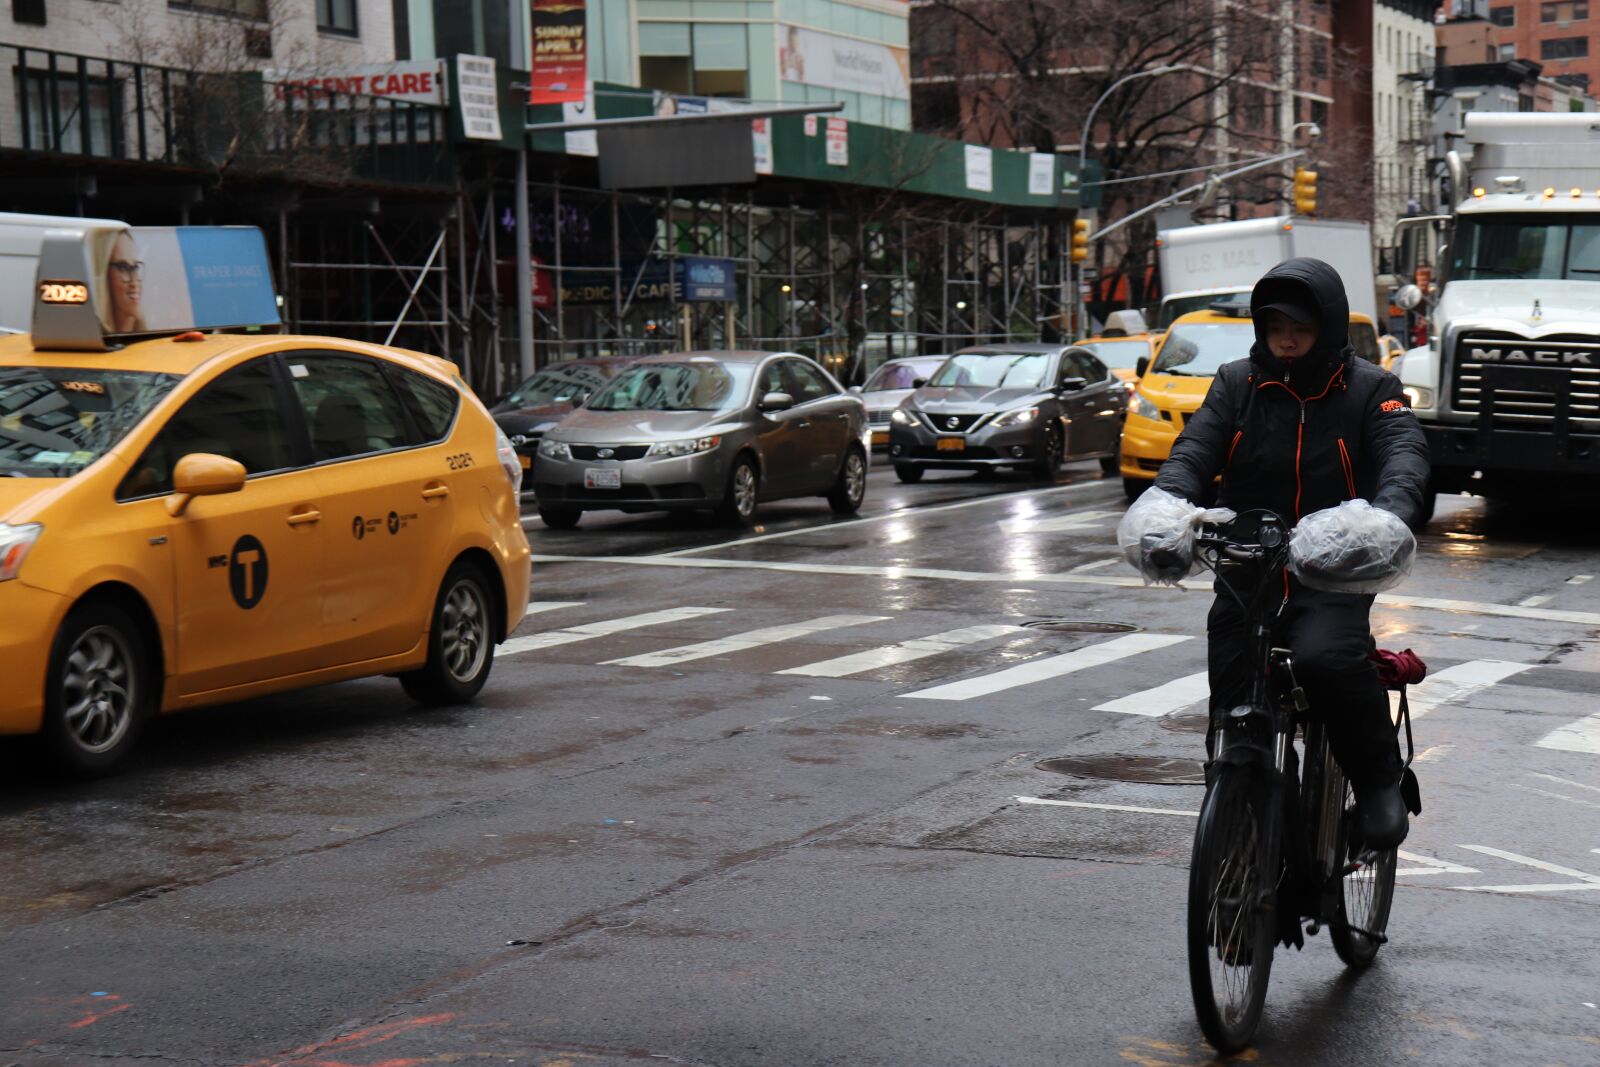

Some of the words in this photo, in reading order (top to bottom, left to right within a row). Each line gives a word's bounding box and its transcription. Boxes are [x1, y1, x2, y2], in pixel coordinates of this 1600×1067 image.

[535, 25, 584, 38] SUNDAY
[536, 40, 573, 53] APRIL
[575, 39, 584, 53] 7
[370, 72, 433, 97] CARE
[1184, 253, 1217, 274] U.S.
[1221, 248, 1261, 269] MAIL
[39, 284, 88, 303] 2029
[1471, 348, 1593, 365] MACK
[236, 549, 260, 601] T
